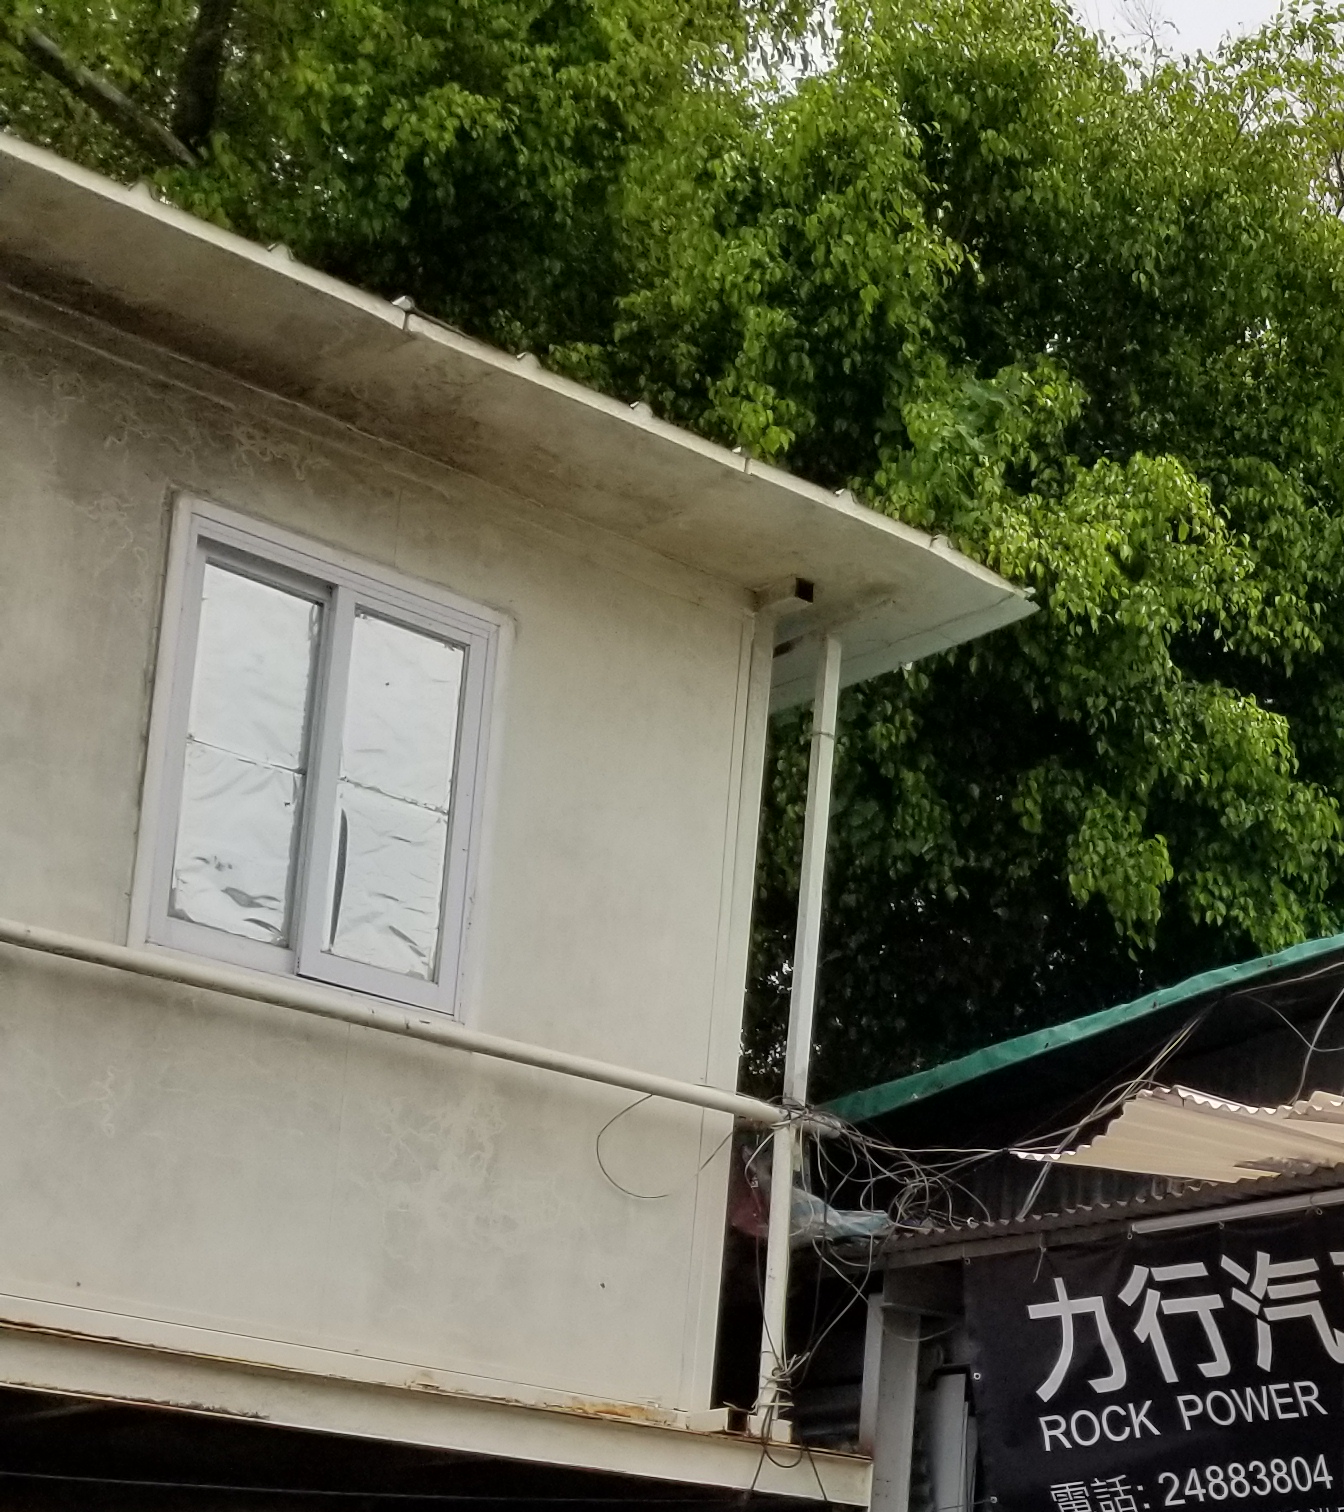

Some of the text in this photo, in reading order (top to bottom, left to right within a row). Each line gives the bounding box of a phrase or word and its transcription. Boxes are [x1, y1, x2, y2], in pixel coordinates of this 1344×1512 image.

[1038, 1400, 1160, 1451] ROCK
[1178, 1380, 1328, 1430] POWER
[1158, 1454, 1332, 1507] 24883804
